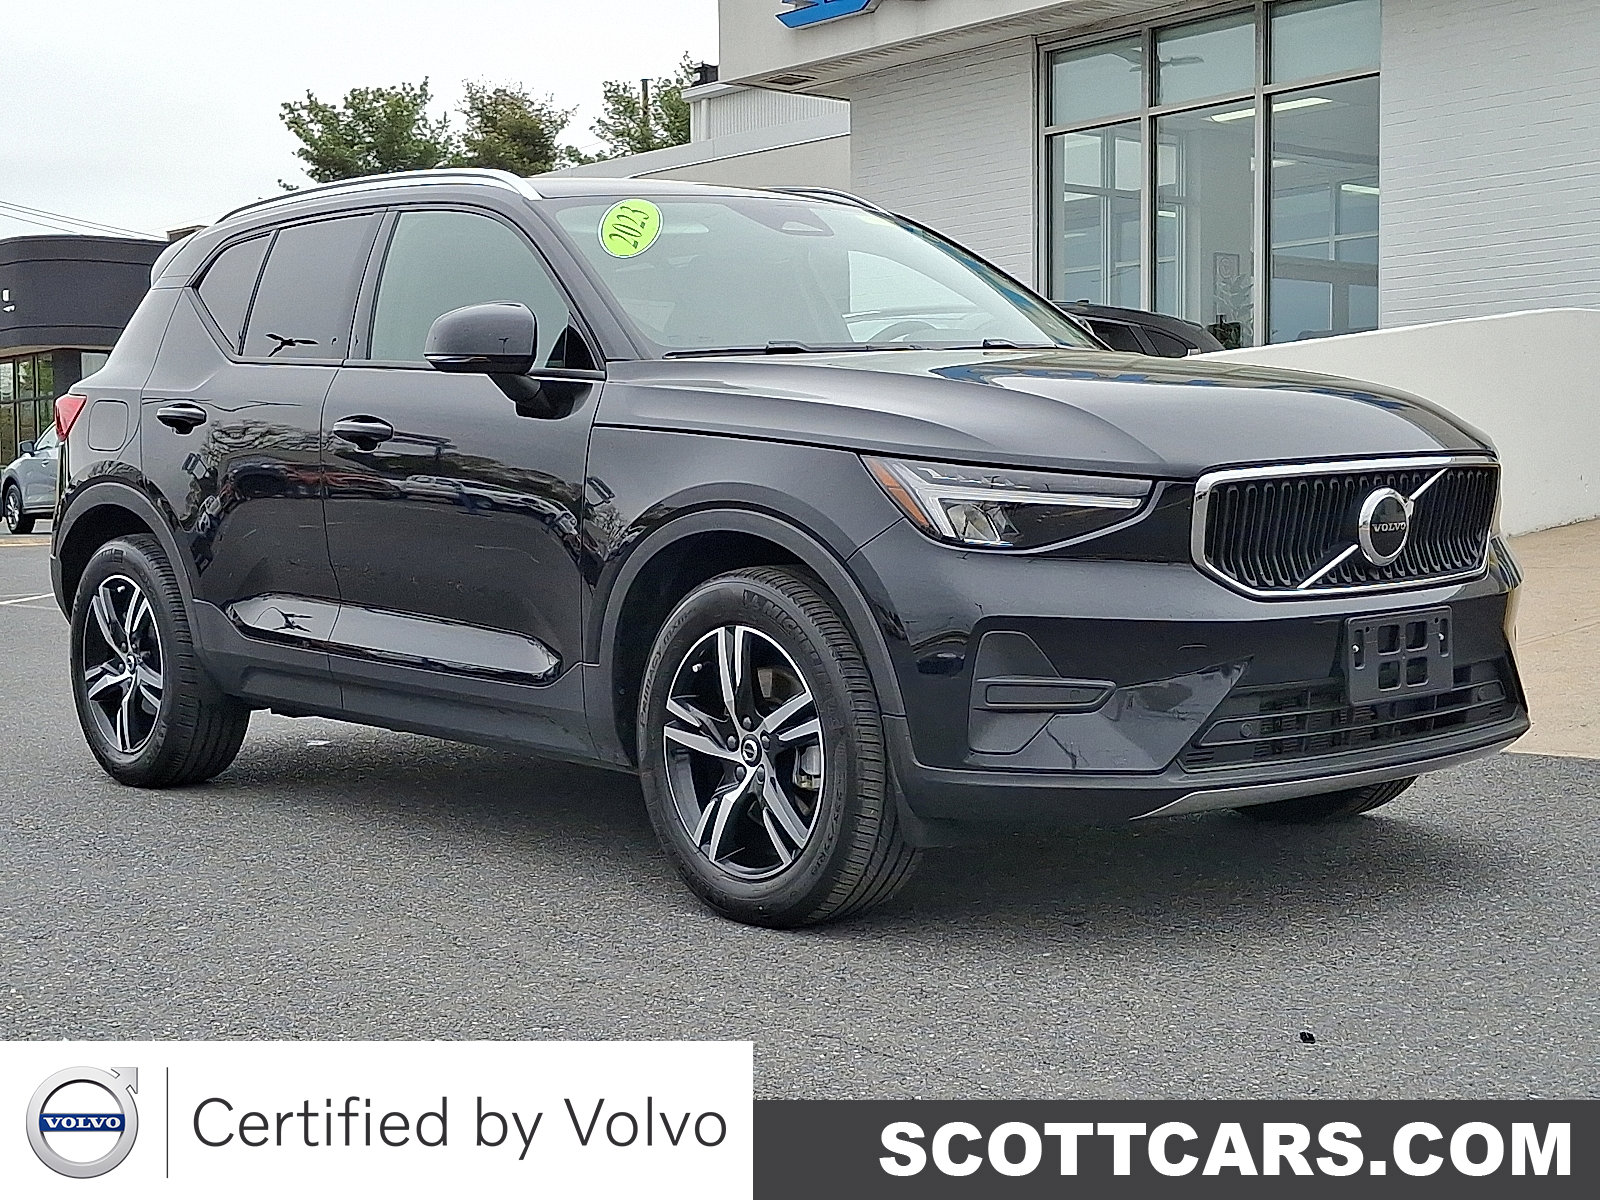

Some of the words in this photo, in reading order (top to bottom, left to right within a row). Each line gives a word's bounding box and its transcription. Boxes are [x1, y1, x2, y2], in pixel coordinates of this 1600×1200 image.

[608, 205, 650, 250] 2023
[1371, 521, 1407, 533] VOLVO
[639, 647, 663, 728] PRIMACY
